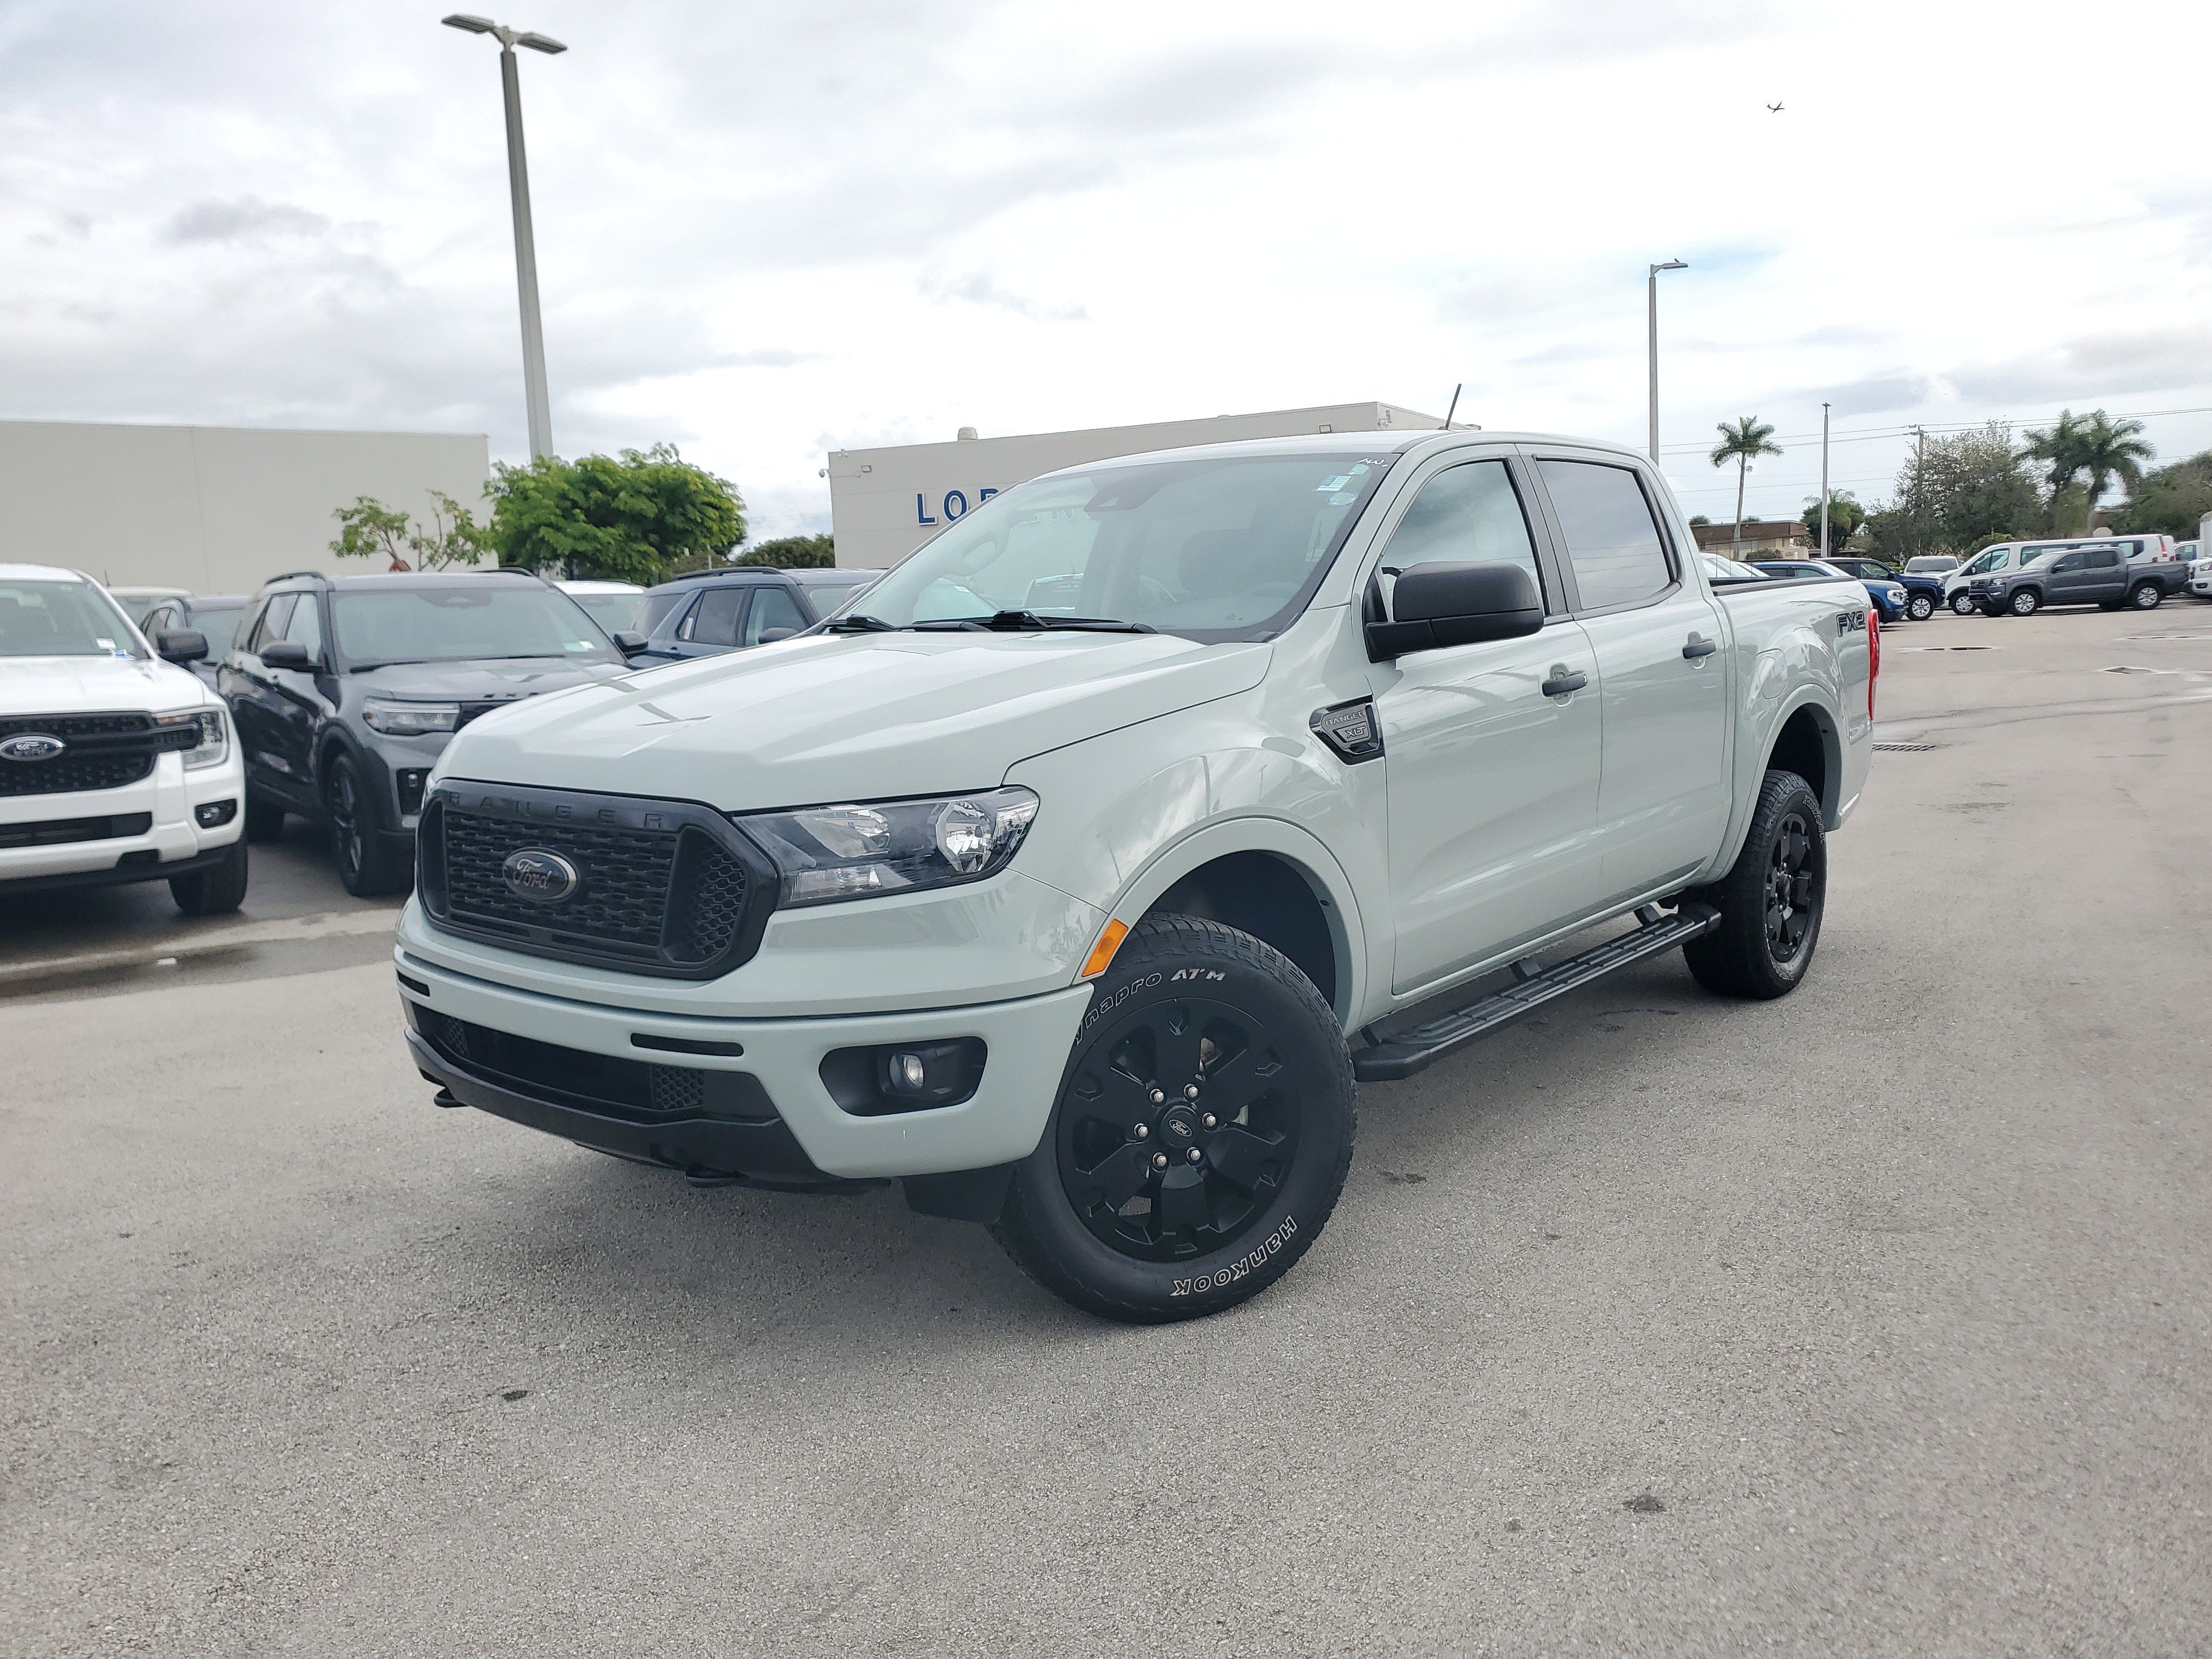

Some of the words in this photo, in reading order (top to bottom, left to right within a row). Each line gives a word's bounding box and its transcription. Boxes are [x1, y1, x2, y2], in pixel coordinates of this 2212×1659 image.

[1836, 611, 1866, 637] FX2
[1325, 710, 1365, 726] RANGER
[1345, 726, 1366, 738] XLT
[450, 791, 663, 829] RANGER
[512, 858, 552, 889] Ford
[1172, 1122, 1189, 1134] Ford
